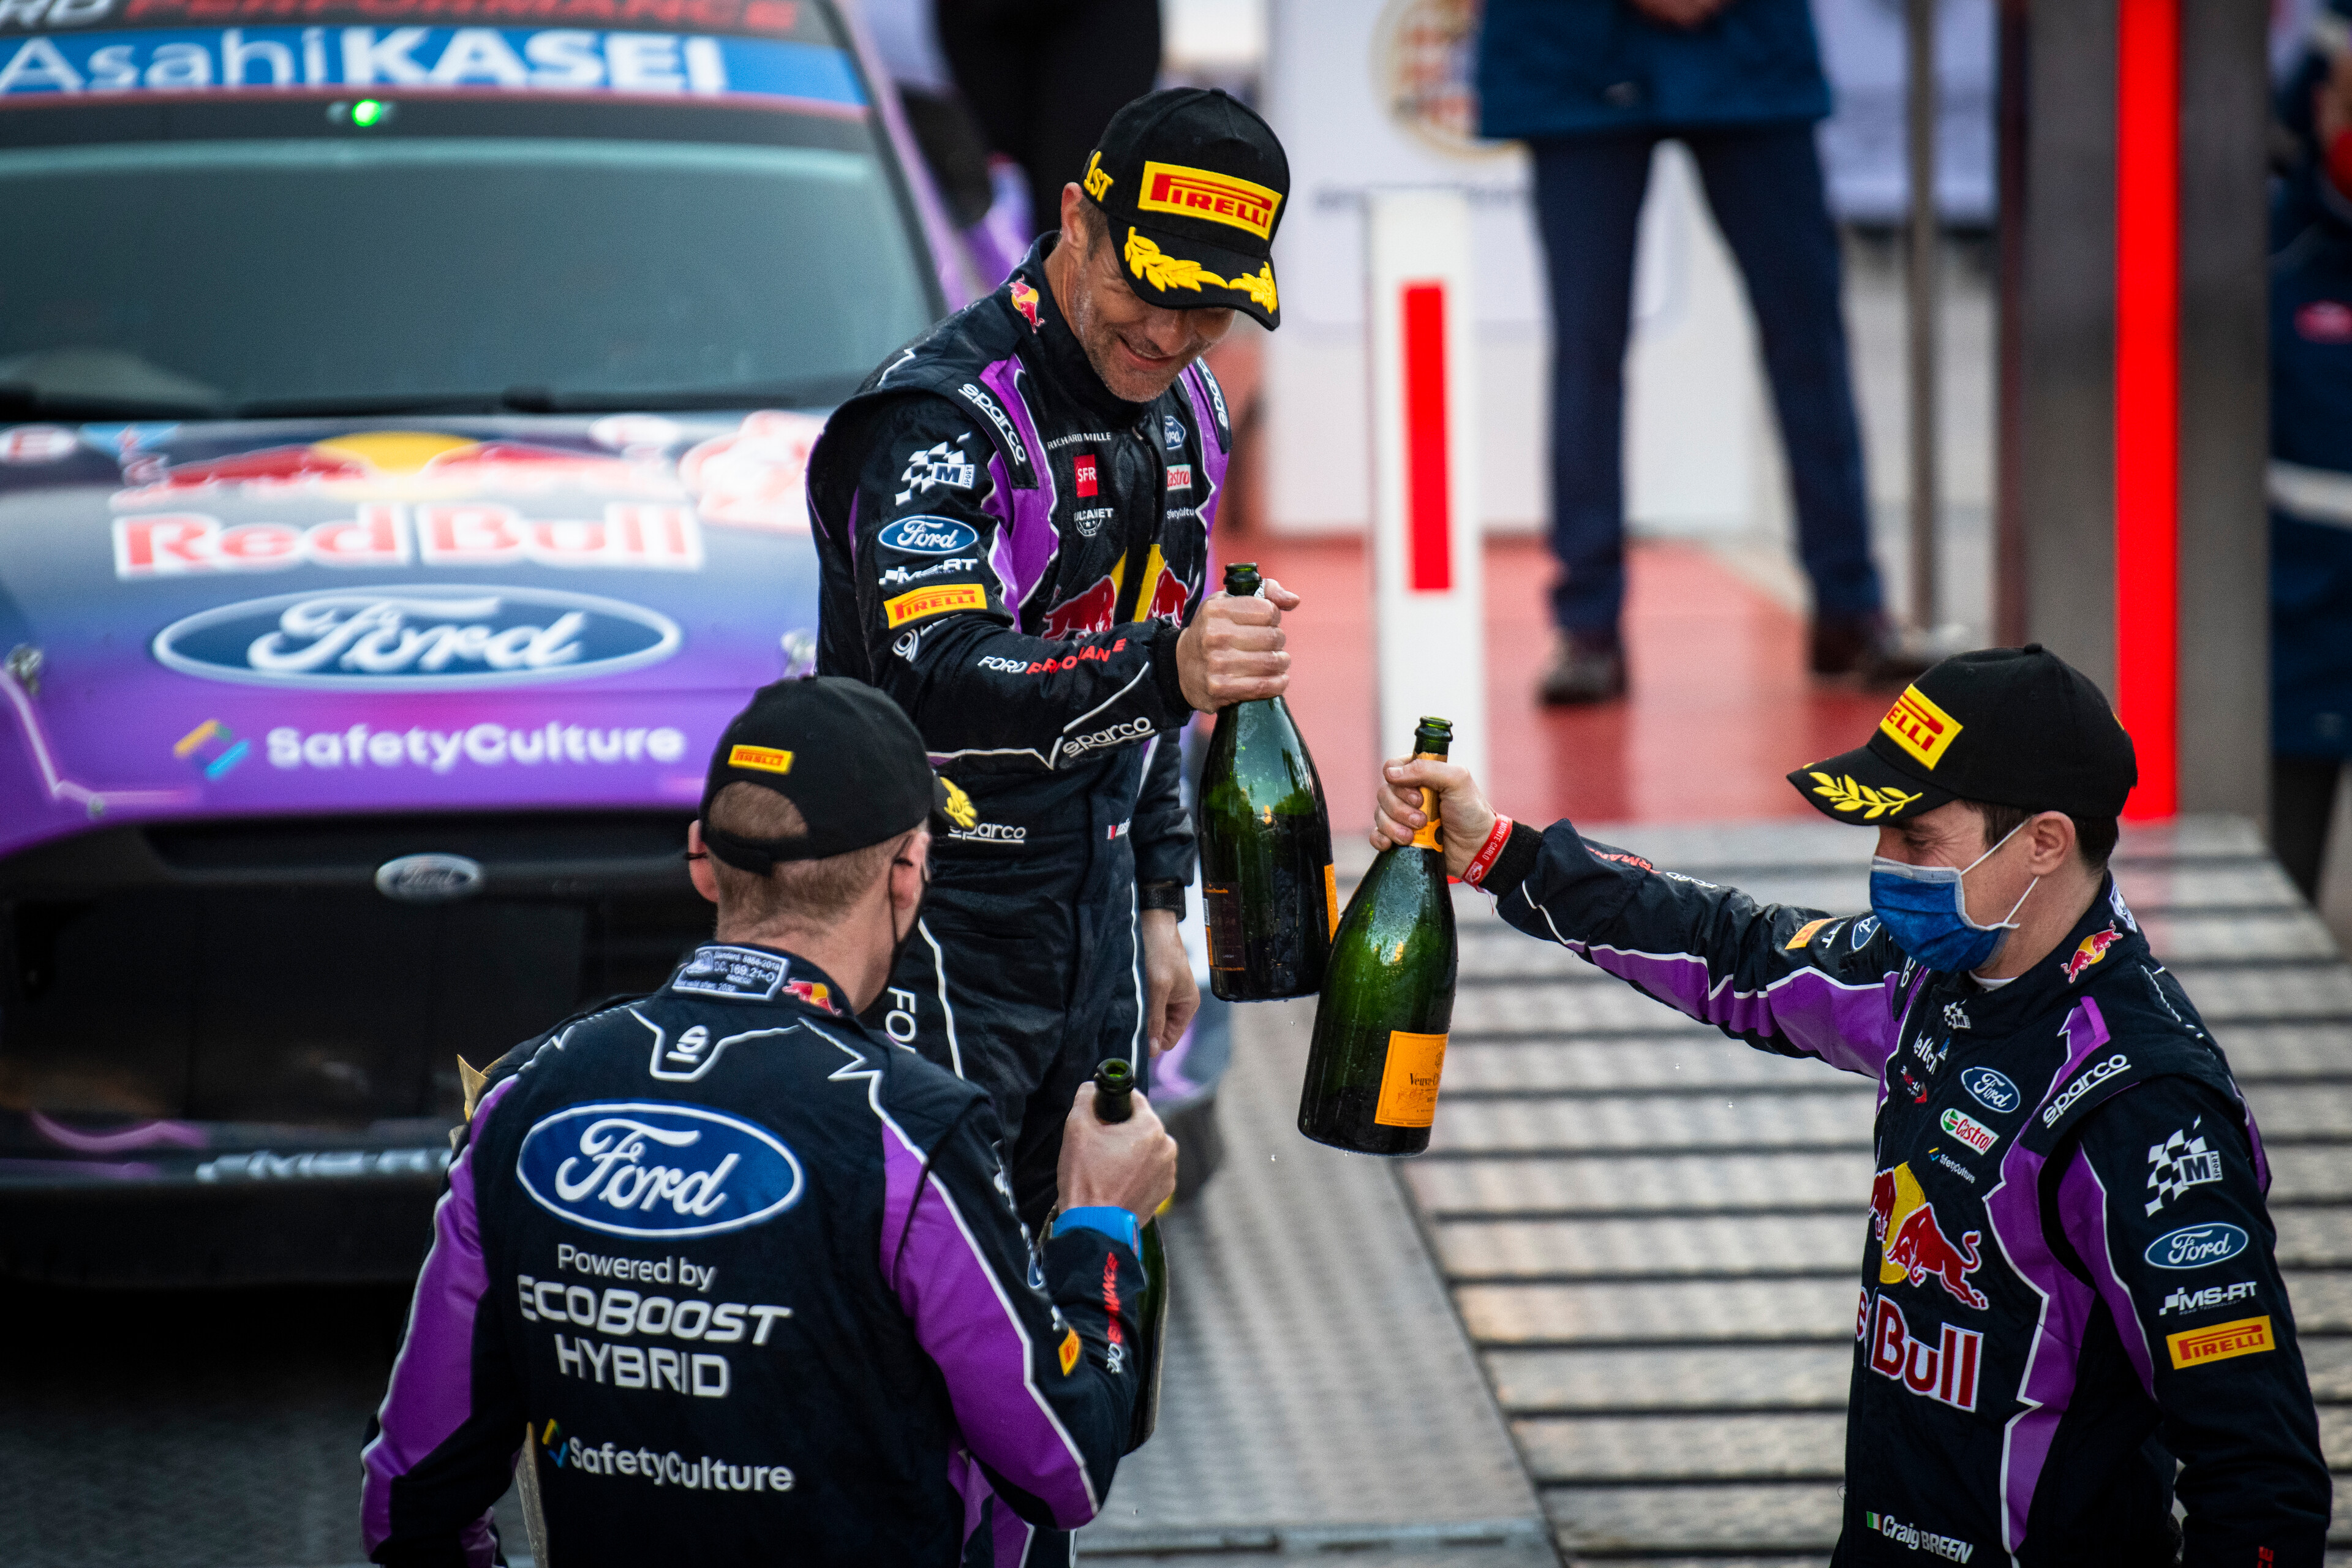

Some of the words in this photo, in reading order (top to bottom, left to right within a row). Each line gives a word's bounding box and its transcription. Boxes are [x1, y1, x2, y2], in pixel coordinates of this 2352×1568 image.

[1084, 151, 1114, 202] 1ST
[1150, 172, 1272, 228] PIRELLI
[958, 383, 1027, 466] sparco
[1047, 433, 1082, 450] RICHARD
[1082, 432, 1112, 443] MILLE
[935, 465, 961, 483] M
[963, 466, 972, 486] SPORT
[1077, 467, 1096, 482] SFR
[116, 503, 410, 577] Red
[418, 502, 701, 570] Bull
[897, 520, 959, 548] Ford
[894, 589, 975, 620] PIRELLI
[247, 595, 587, 673] Ford
[978, 655, 1028, 674] FORD
[1063, 717, 1155, 758] sparco
[1887, 699, 1940, 752] ELLI
[266, 722, 686, 775] SafetyCulture
[1973, 1072, 2013, 1107] Ford
[2043, 1054, 2131, 1129] sparco
[1956, 1118, 1994, 1152] Castrol
[556, 1118, 741, 1217] Ford
[2182, 1155, 2211, 1182] M
[2211, 1153, 2222, 1178] SPORT
[557, 1243, 673, 1284] Powered
[678, 1257, 717, 1292] by
[2168, 1229, 2231, 1264] Ford
[518, 1274, 793, 1346] ECOBOOST
[2179, 1281, 2257, 1311] MS-RT
[1871, 1294, 1983, 1412] Bull
[2177, 1324, 2264, 1360] PIRELLI
[554, 1333, 731, 1399] HYBRID
[569, 1436, 796, 1492] SafetyCulture
[1882, 1515, 1920, 1551] Craig
[1920, 1530, 1974, 1564] BREEN
